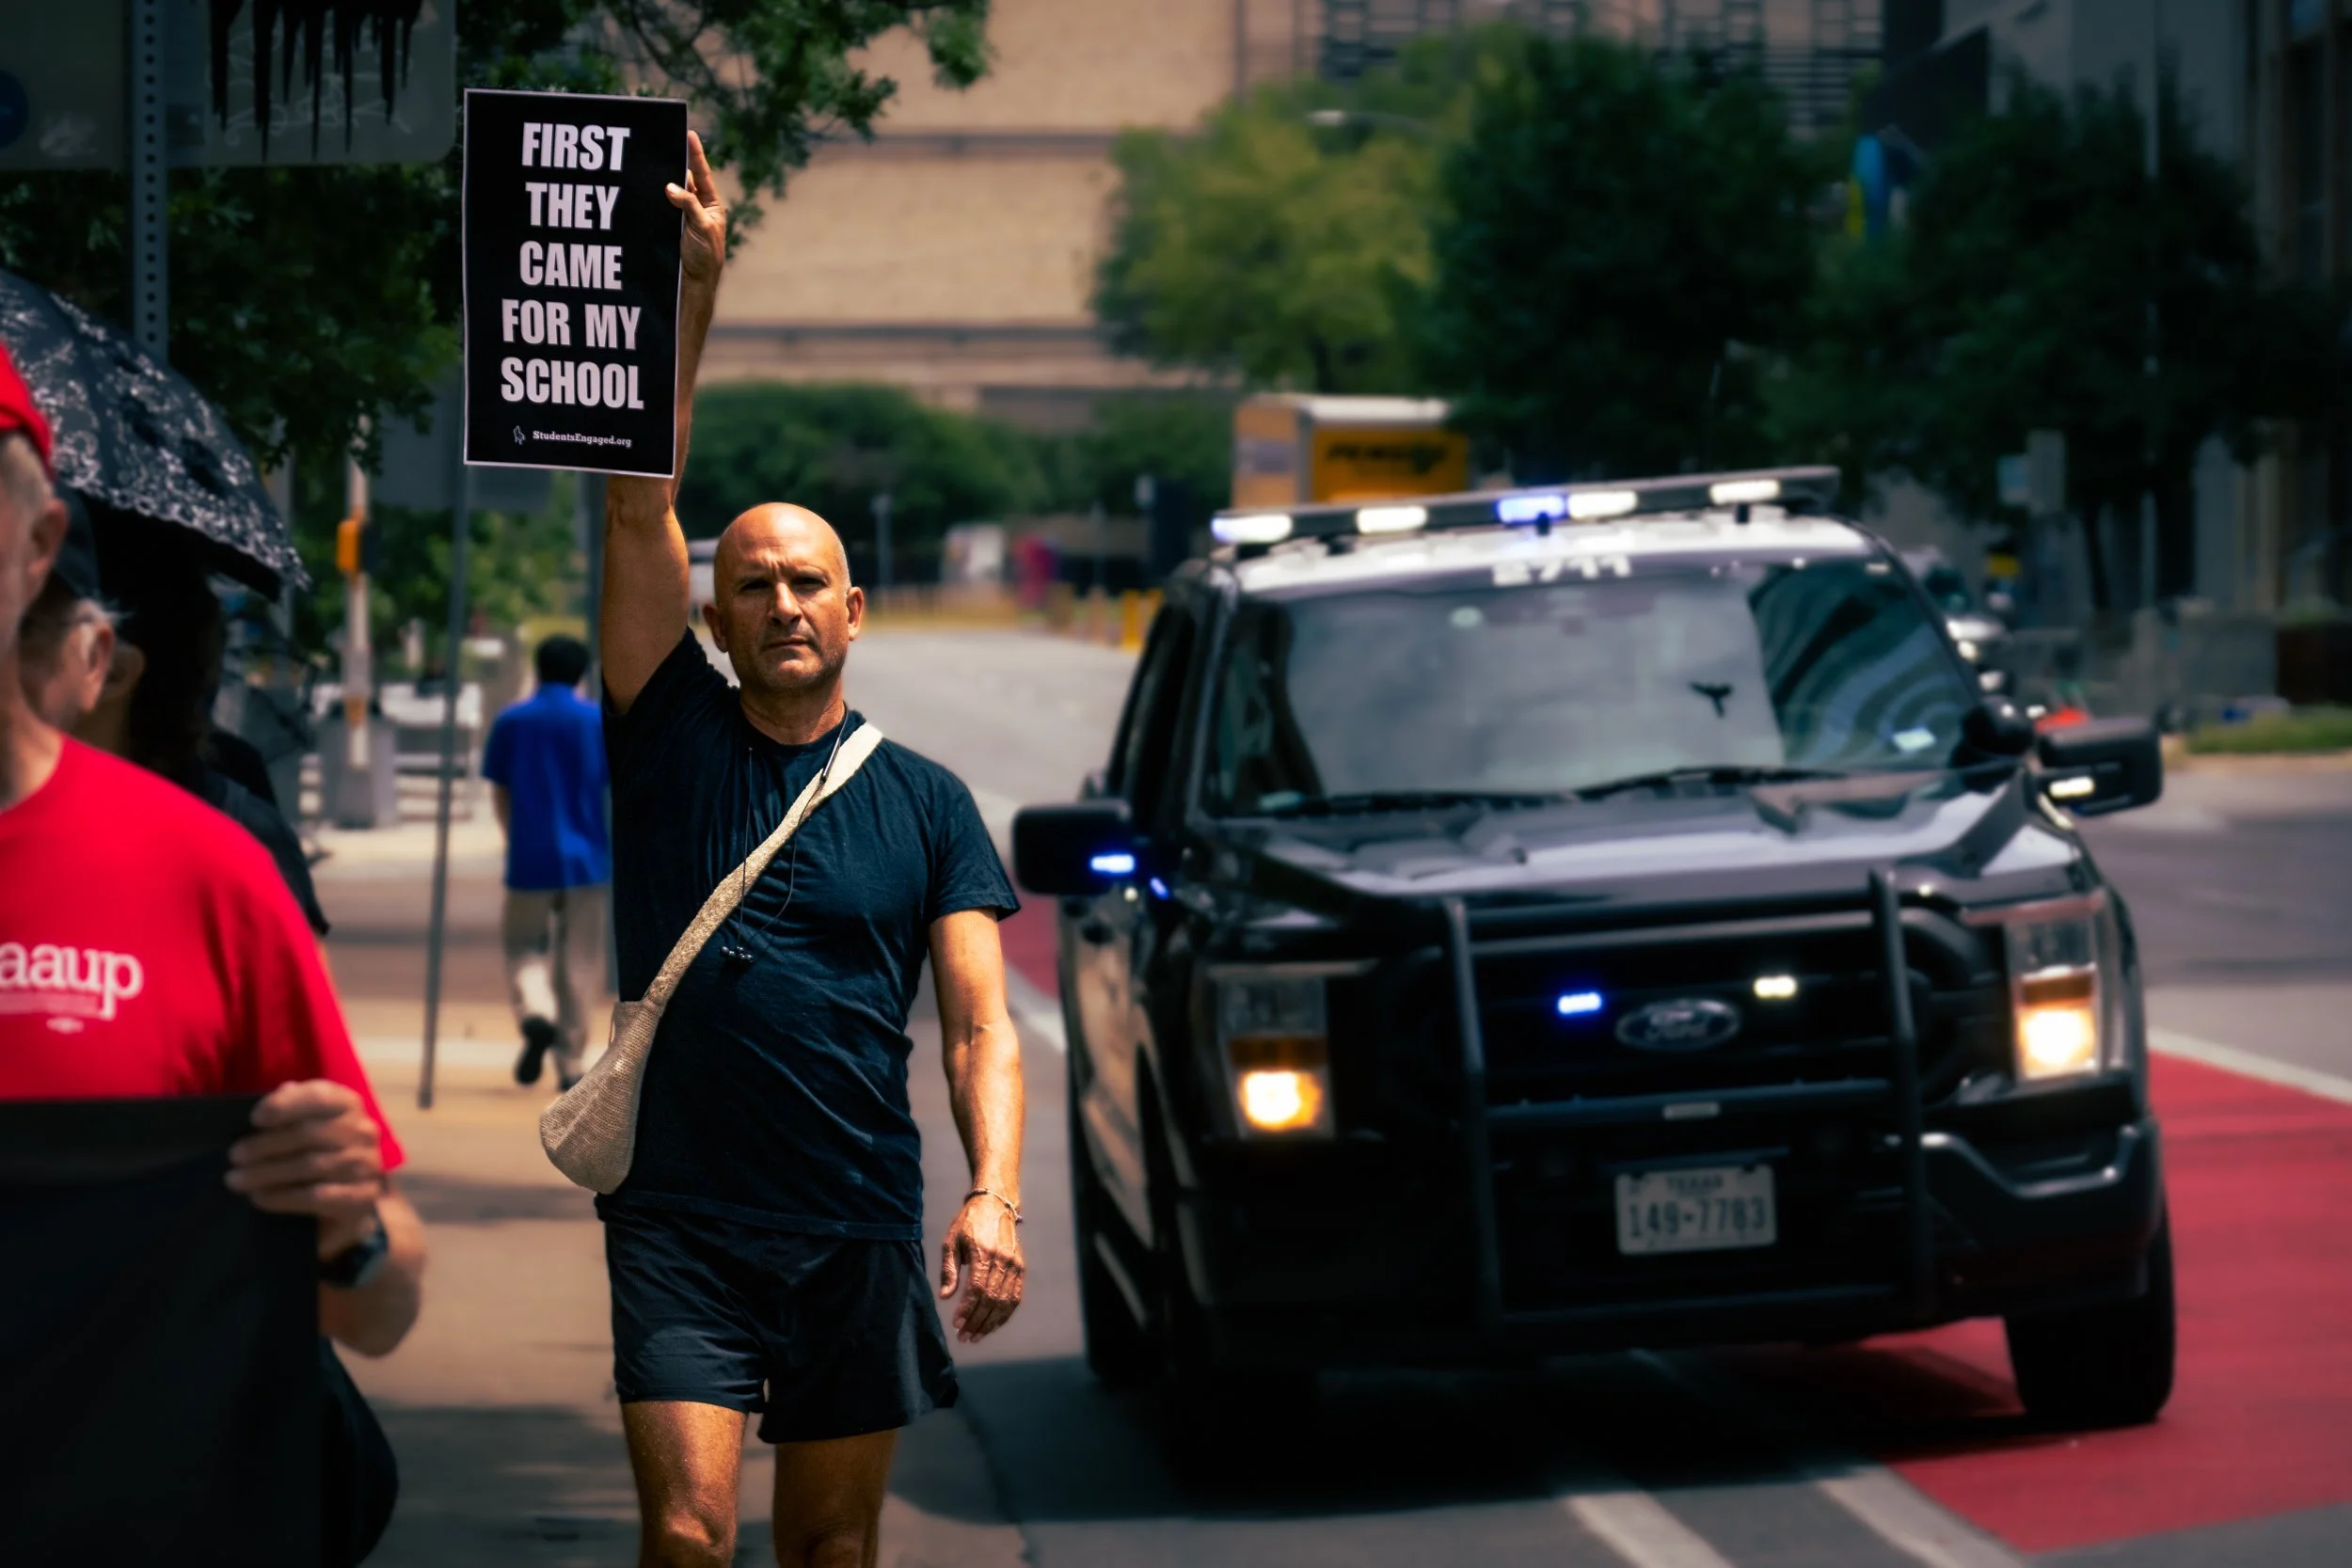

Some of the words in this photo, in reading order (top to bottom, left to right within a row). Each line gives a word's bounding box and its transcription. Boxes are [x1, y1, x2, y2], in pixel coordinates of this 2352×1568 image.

[521, 121, 631, 171] FIRST
[524, 182, 620, 230] THEY
[518, 240, 623, 290] CAME
[501, 298, 571, 346] FOR
[584, 303, 642, 350] MY
[501, 356, 644, 410] SCHOOL
[532, 430, 632, 449] StudentsEngaged.org
[0, 942, 144, 1020] aaup
